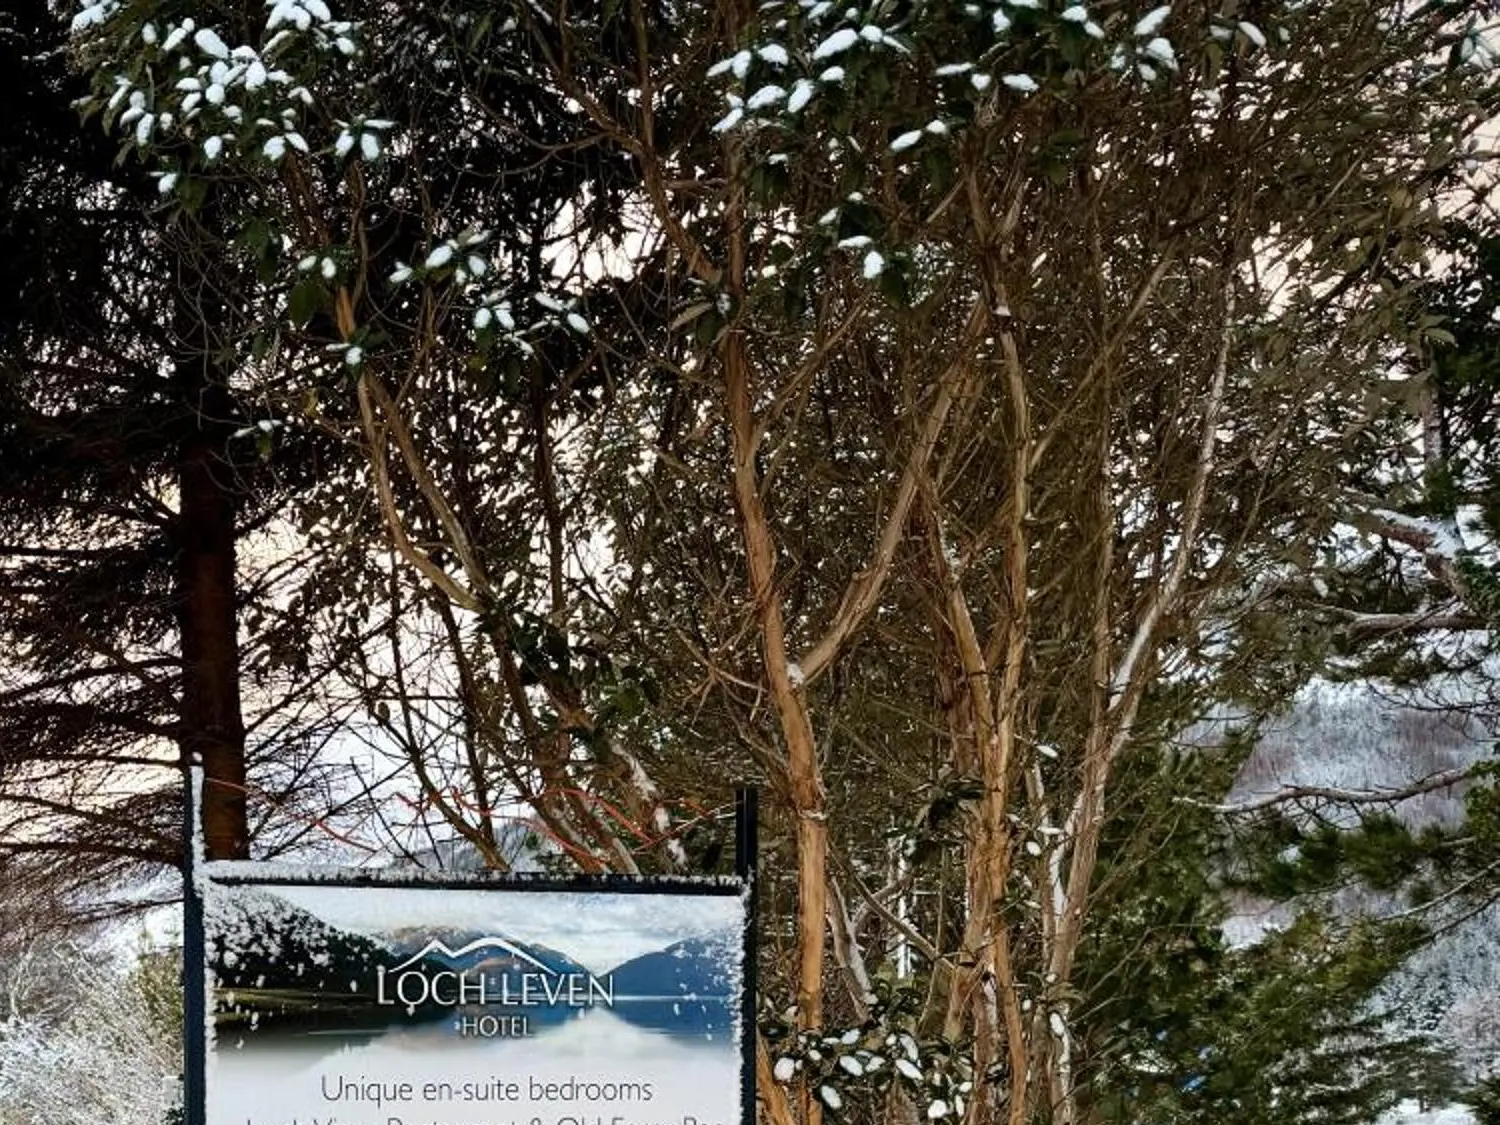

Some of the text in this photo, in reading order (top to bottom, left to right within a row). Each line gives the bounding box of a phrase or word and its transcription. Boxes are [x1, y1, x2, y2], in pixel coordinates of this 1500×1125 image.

[377, 970, 613, 1006] LOCH LEVEN
[463, 1015, 533, 1037] HOTEL
[321, 1075, 653, 1109] Unique en-suite bedrooms
